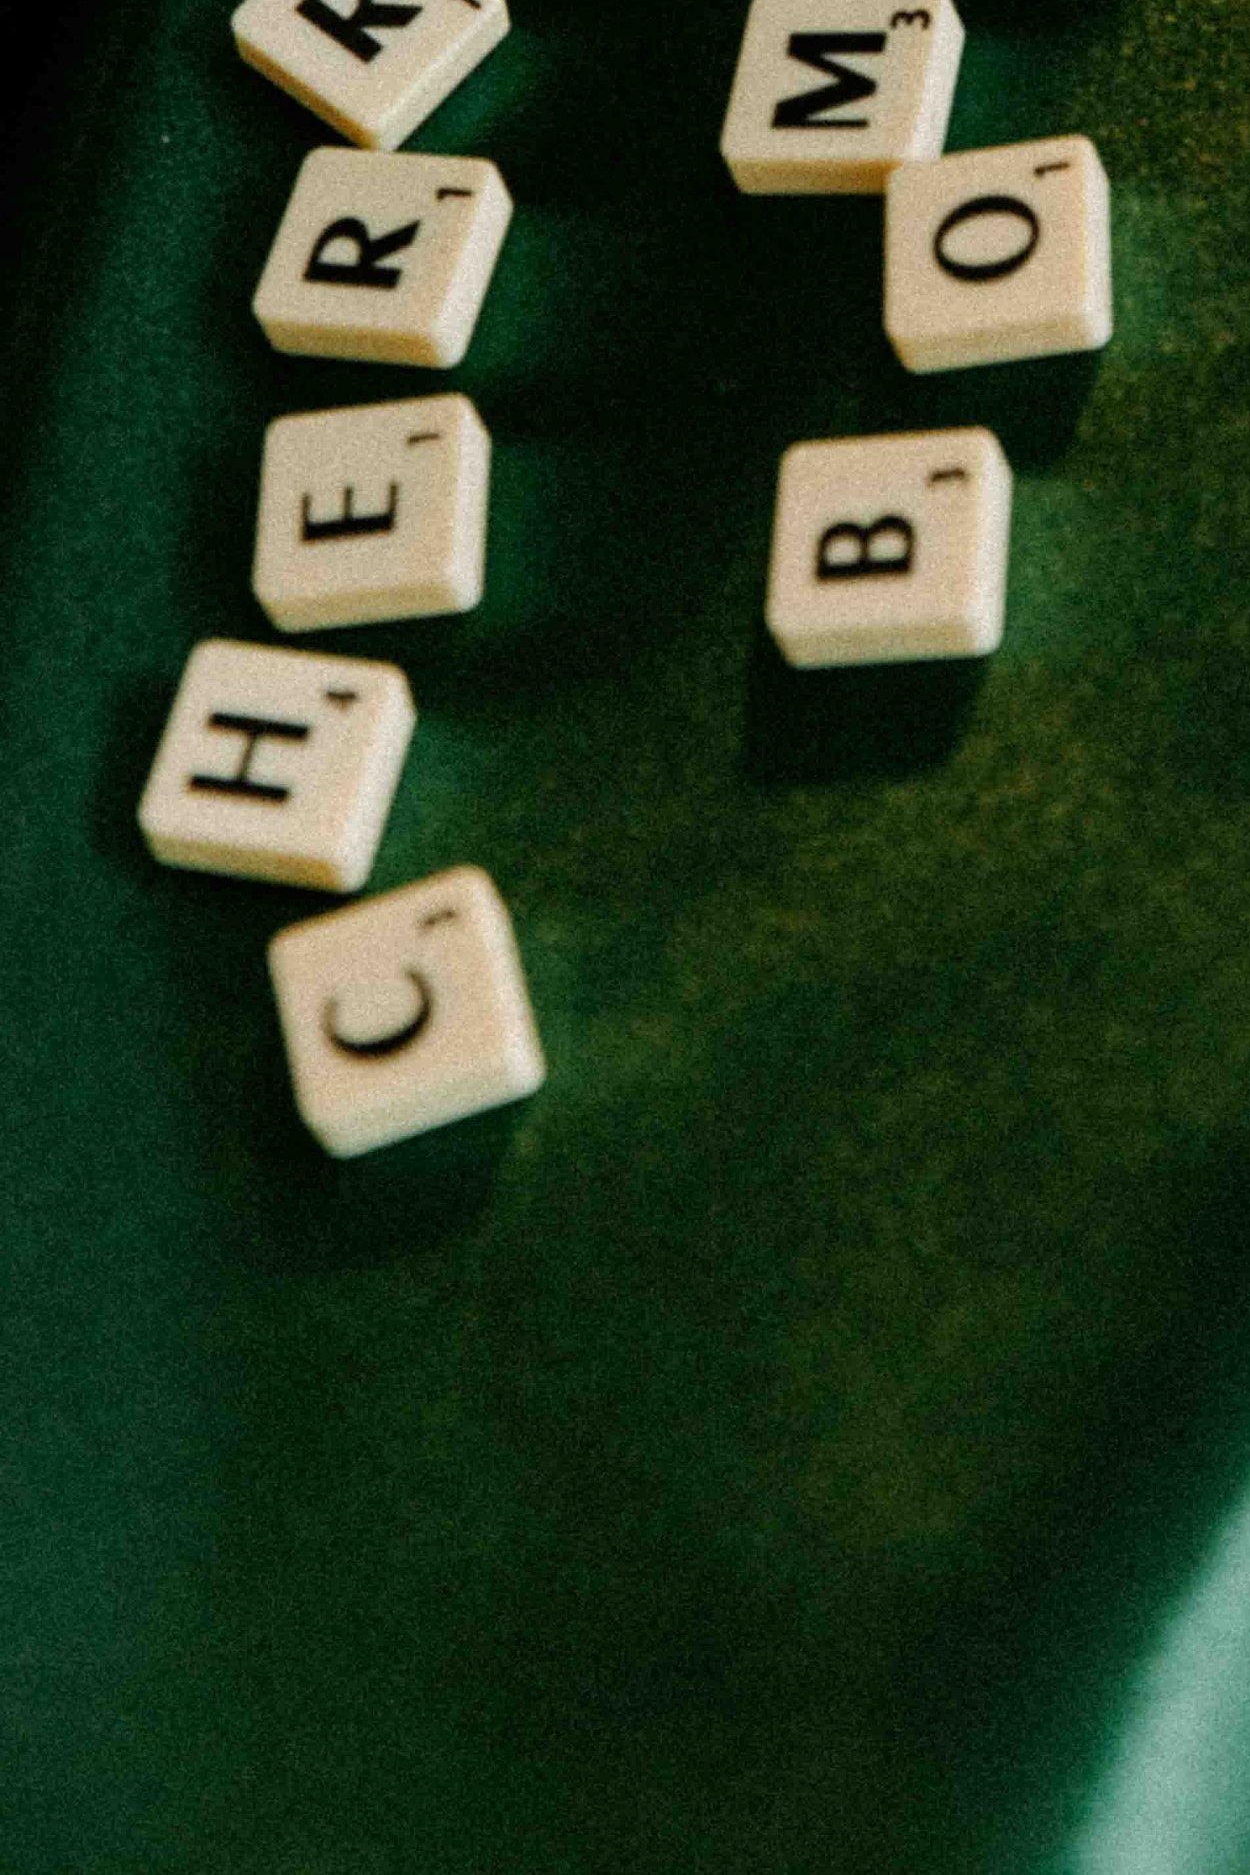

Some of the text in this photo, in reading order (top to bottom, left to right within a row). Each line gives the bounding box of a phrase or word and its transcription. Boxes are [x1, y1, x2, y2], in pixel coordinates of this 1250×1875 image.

[768, 7, 933, 132] M 3
[300, 186, 474, 293] R 1
[930, 159, 1072, 288] O 1
[297, 481, 400, 547] E
[811, 512, 918, 587] B
[184, 711, 313, 809] H
[322, 969, 436, 1067] C
